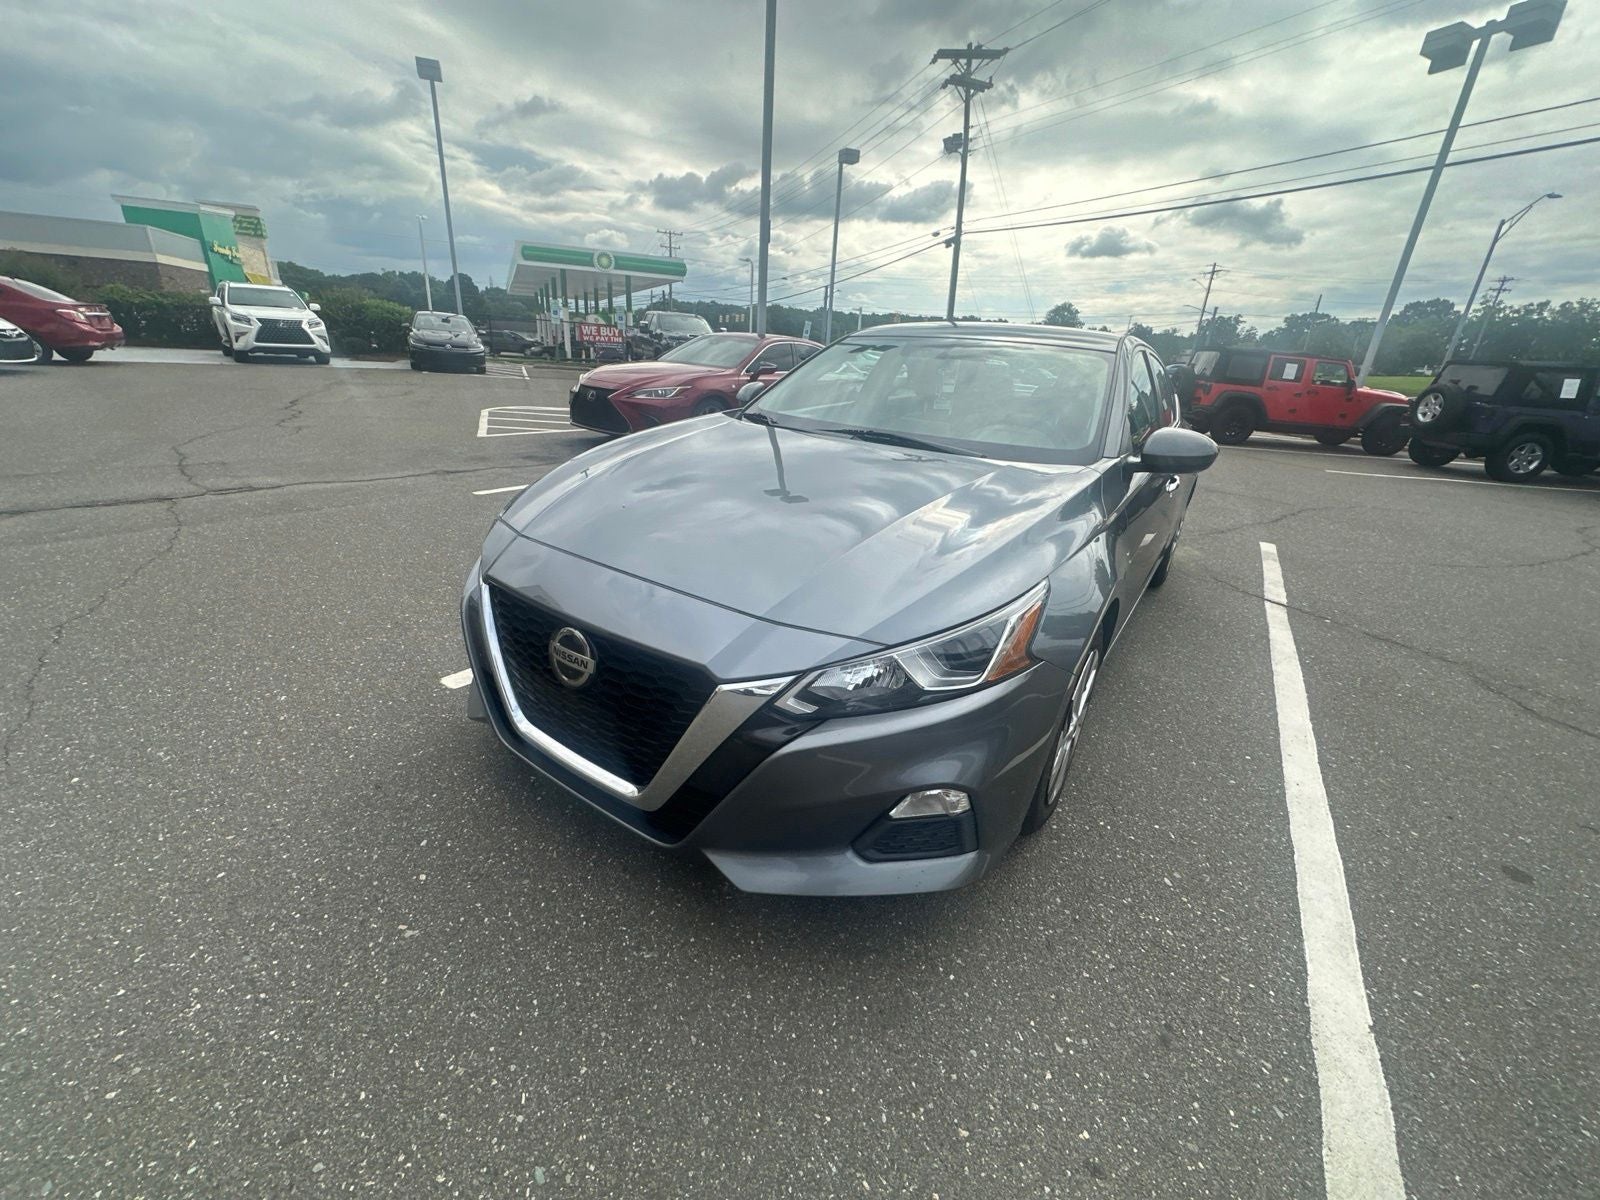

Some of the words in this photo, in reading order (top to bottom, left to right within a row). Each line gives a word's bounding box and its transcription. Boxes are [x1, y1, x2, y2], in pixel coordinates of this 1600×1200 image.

[581, 326, 598, 336] WE
[600, 326, 619, 337] BUY
[553, 645, 589, 669] NISSAN
